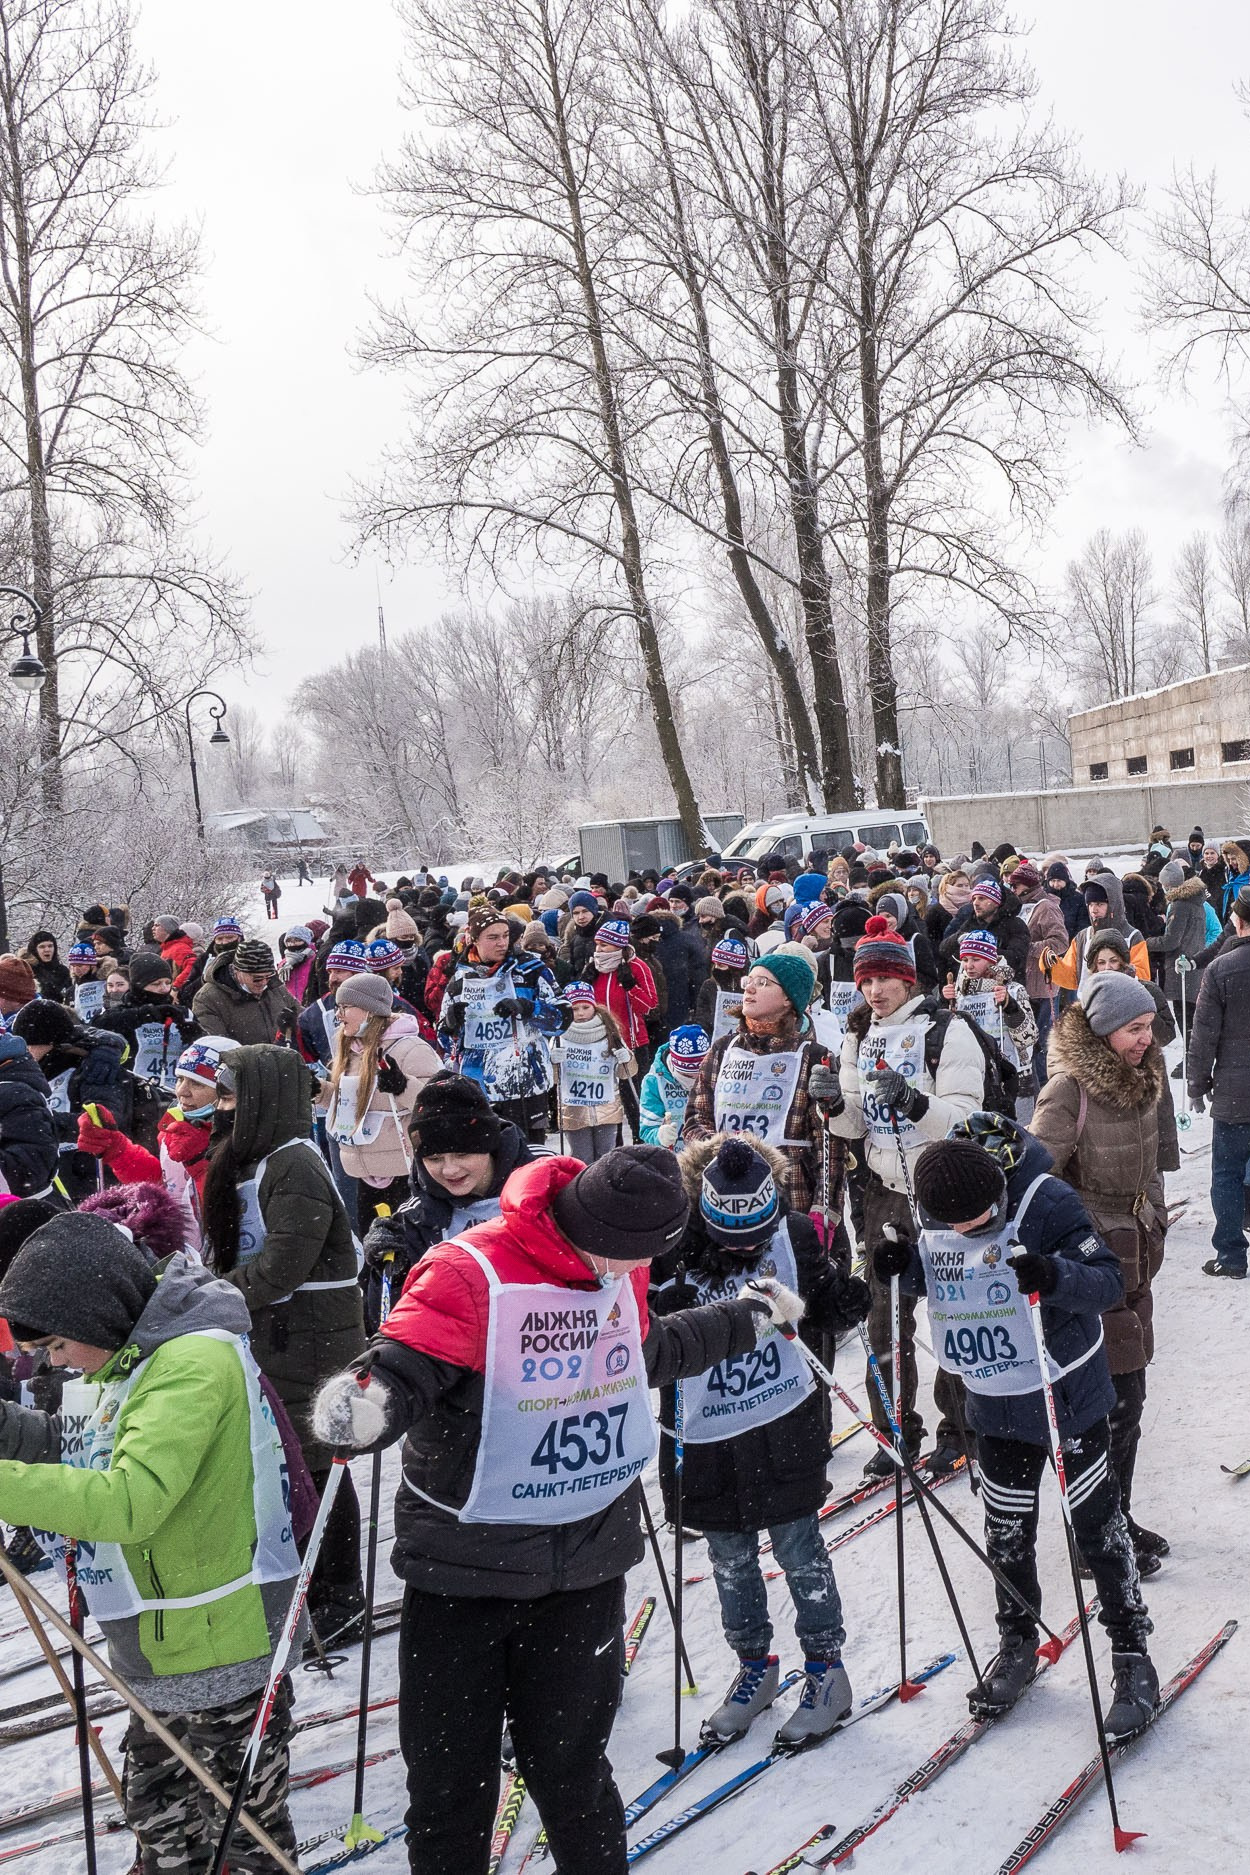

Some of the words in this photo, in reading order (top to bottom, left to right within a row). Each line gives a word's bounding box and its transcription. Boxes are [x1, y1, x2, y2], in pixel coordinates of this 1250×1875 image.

[475, 1020, 513, 1041] 4652
[566, 1054, 592, 1062] РОССИИ
[569, 1080, 604, 1099] 4210
[519, 1309, 598, 1332] ЛЫЖНЯ
[521, 1329, 598, 1354] РОССИИ
[944, 1325, 1018, 1367] 4903
[521, 1356, 582, 1382] 202
[707, 1341, 781, 1398] 4529
[517, 1399, 559, 1413] СПОРТ
[702, 1375, 800, 1418] САНКТ-ПЕТЕРБУРГ
[531, 1402, 629, 1475] 4537
[512, 1457, 648, 1499] САНКТ-ПЕТЕРБУРГ
